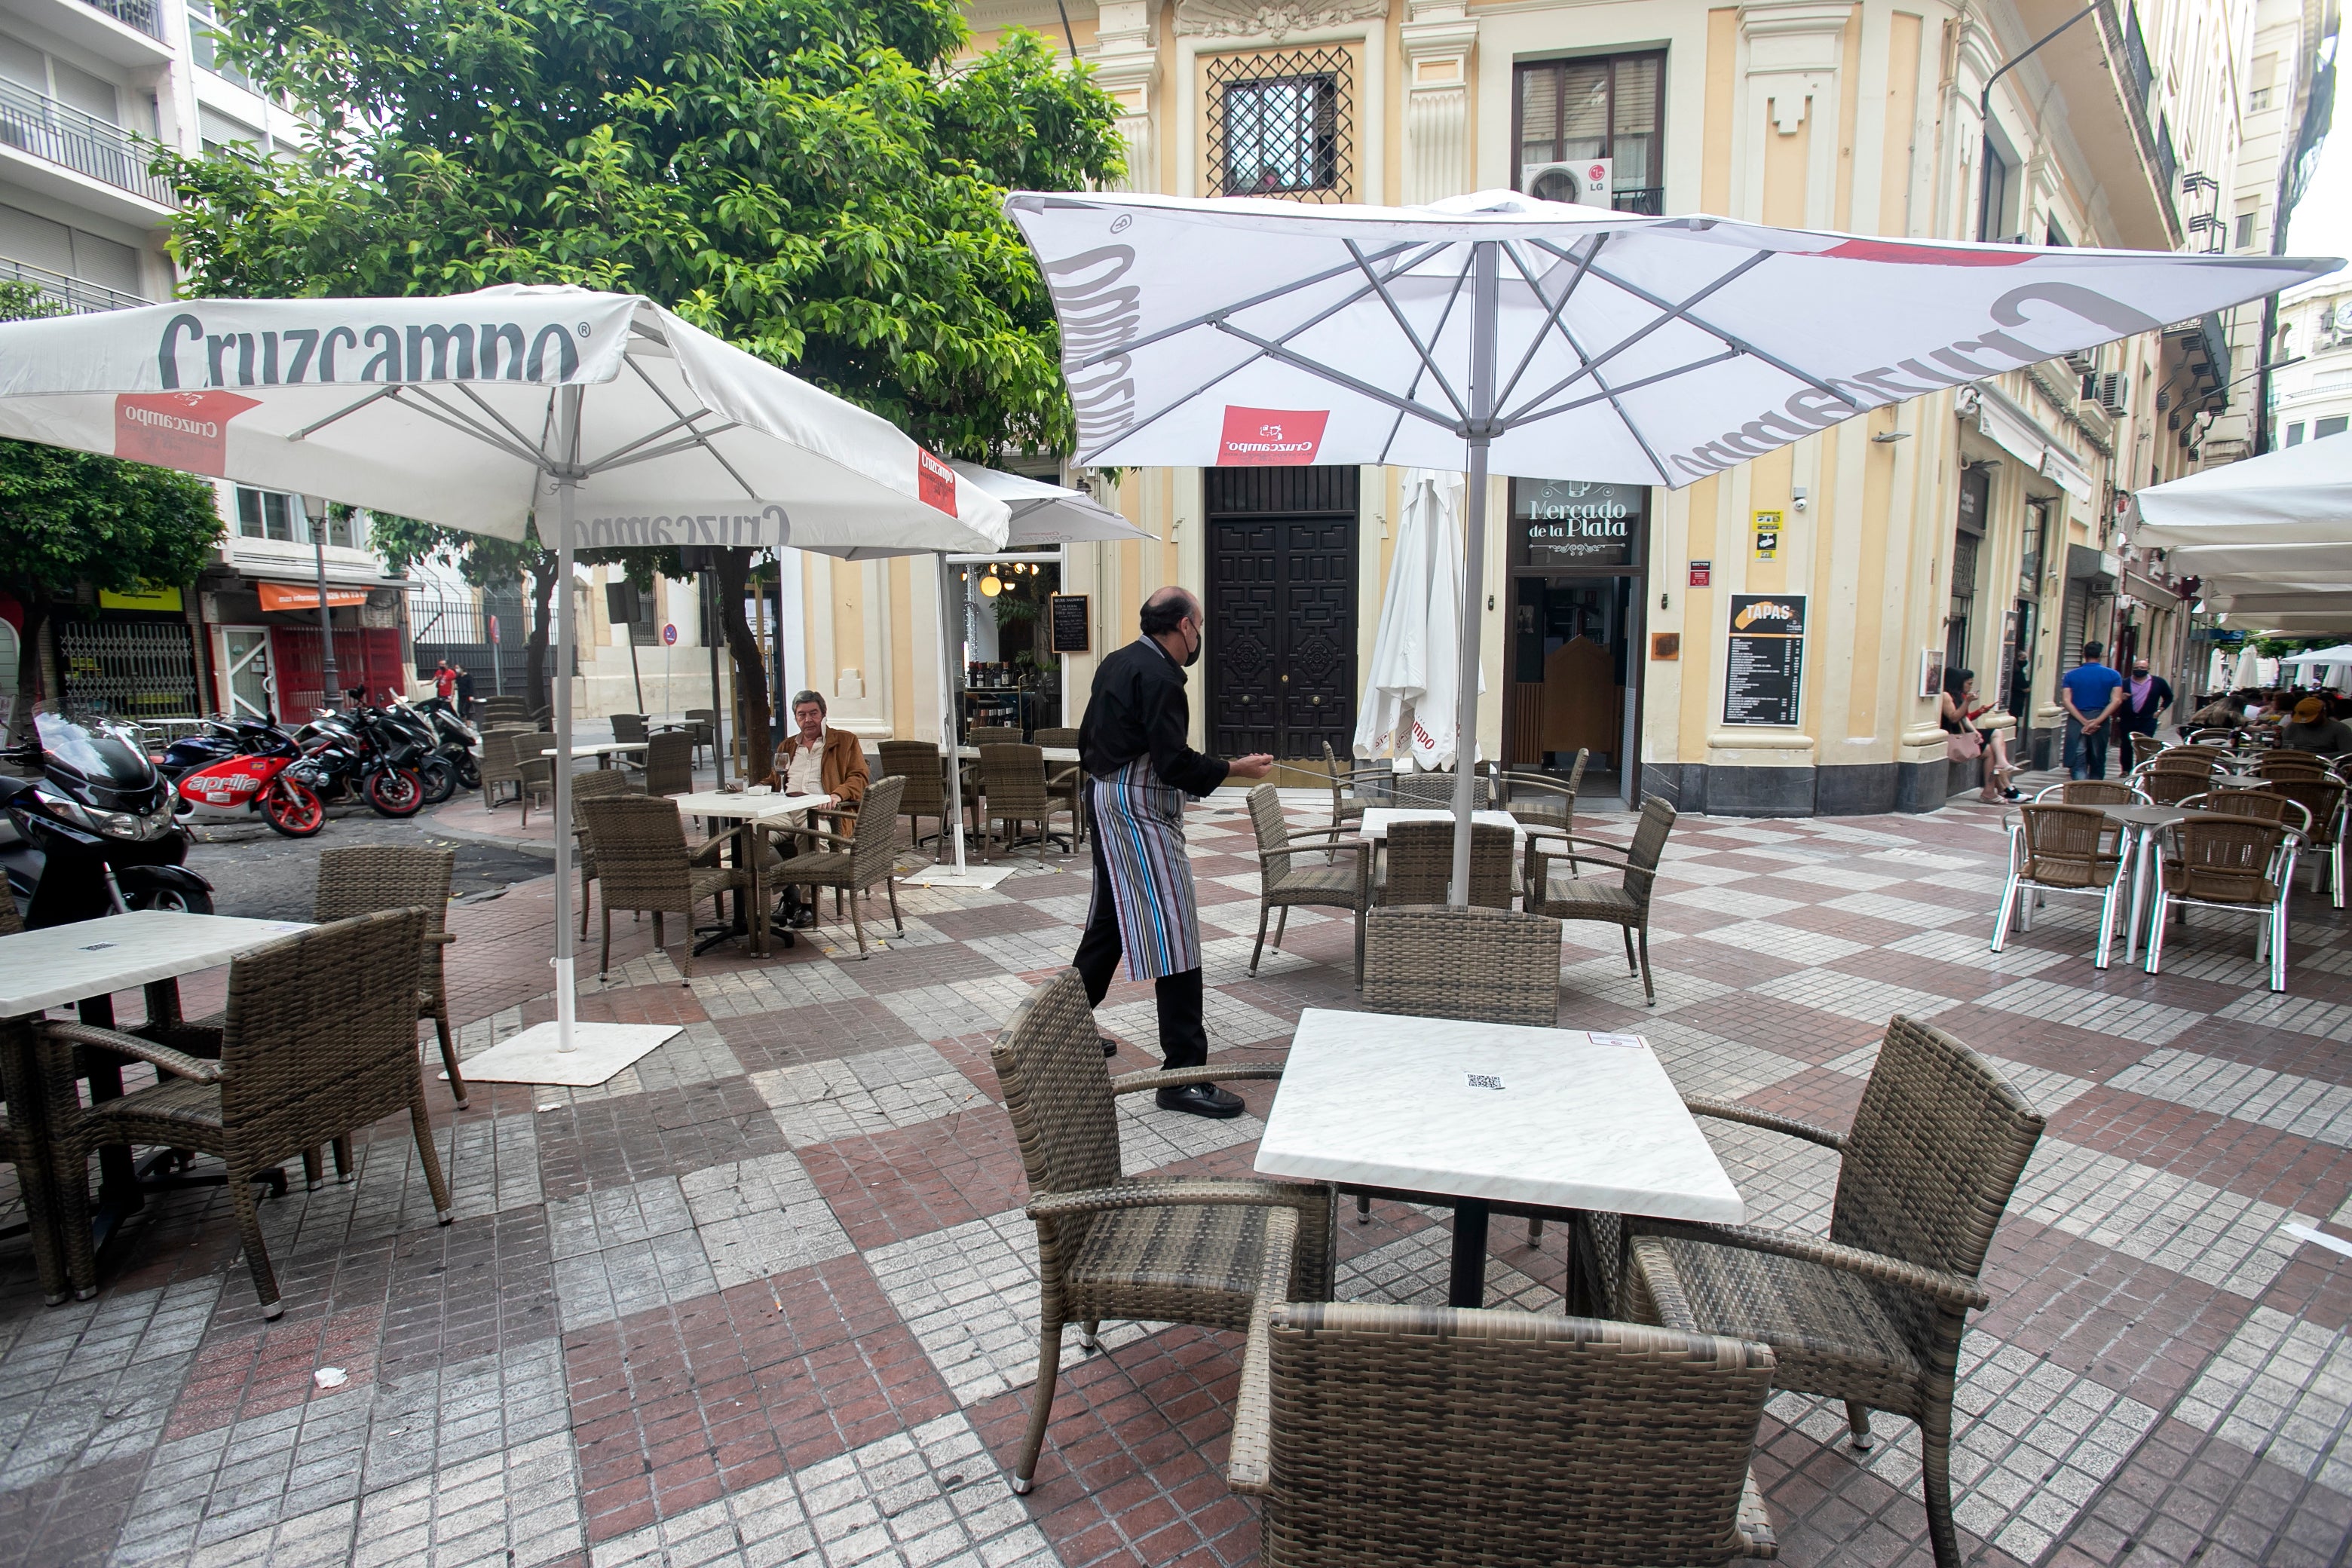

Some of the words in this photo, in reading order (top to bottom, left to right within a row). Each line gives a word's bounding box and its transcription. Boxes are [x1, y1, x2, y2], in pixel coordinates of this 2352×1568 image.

[922, 452, 954, 484] Cruzcampo
[1529, 500, 1627, 519] Mercado
[1529, 525, 1547, 537] de
[1549, 525, 1564, 537] la
[1566, 518, 1628, 537] Plata
[1746, 605, 1790, 620] TAPAS
[187, 773, 261, 793] aprilia
